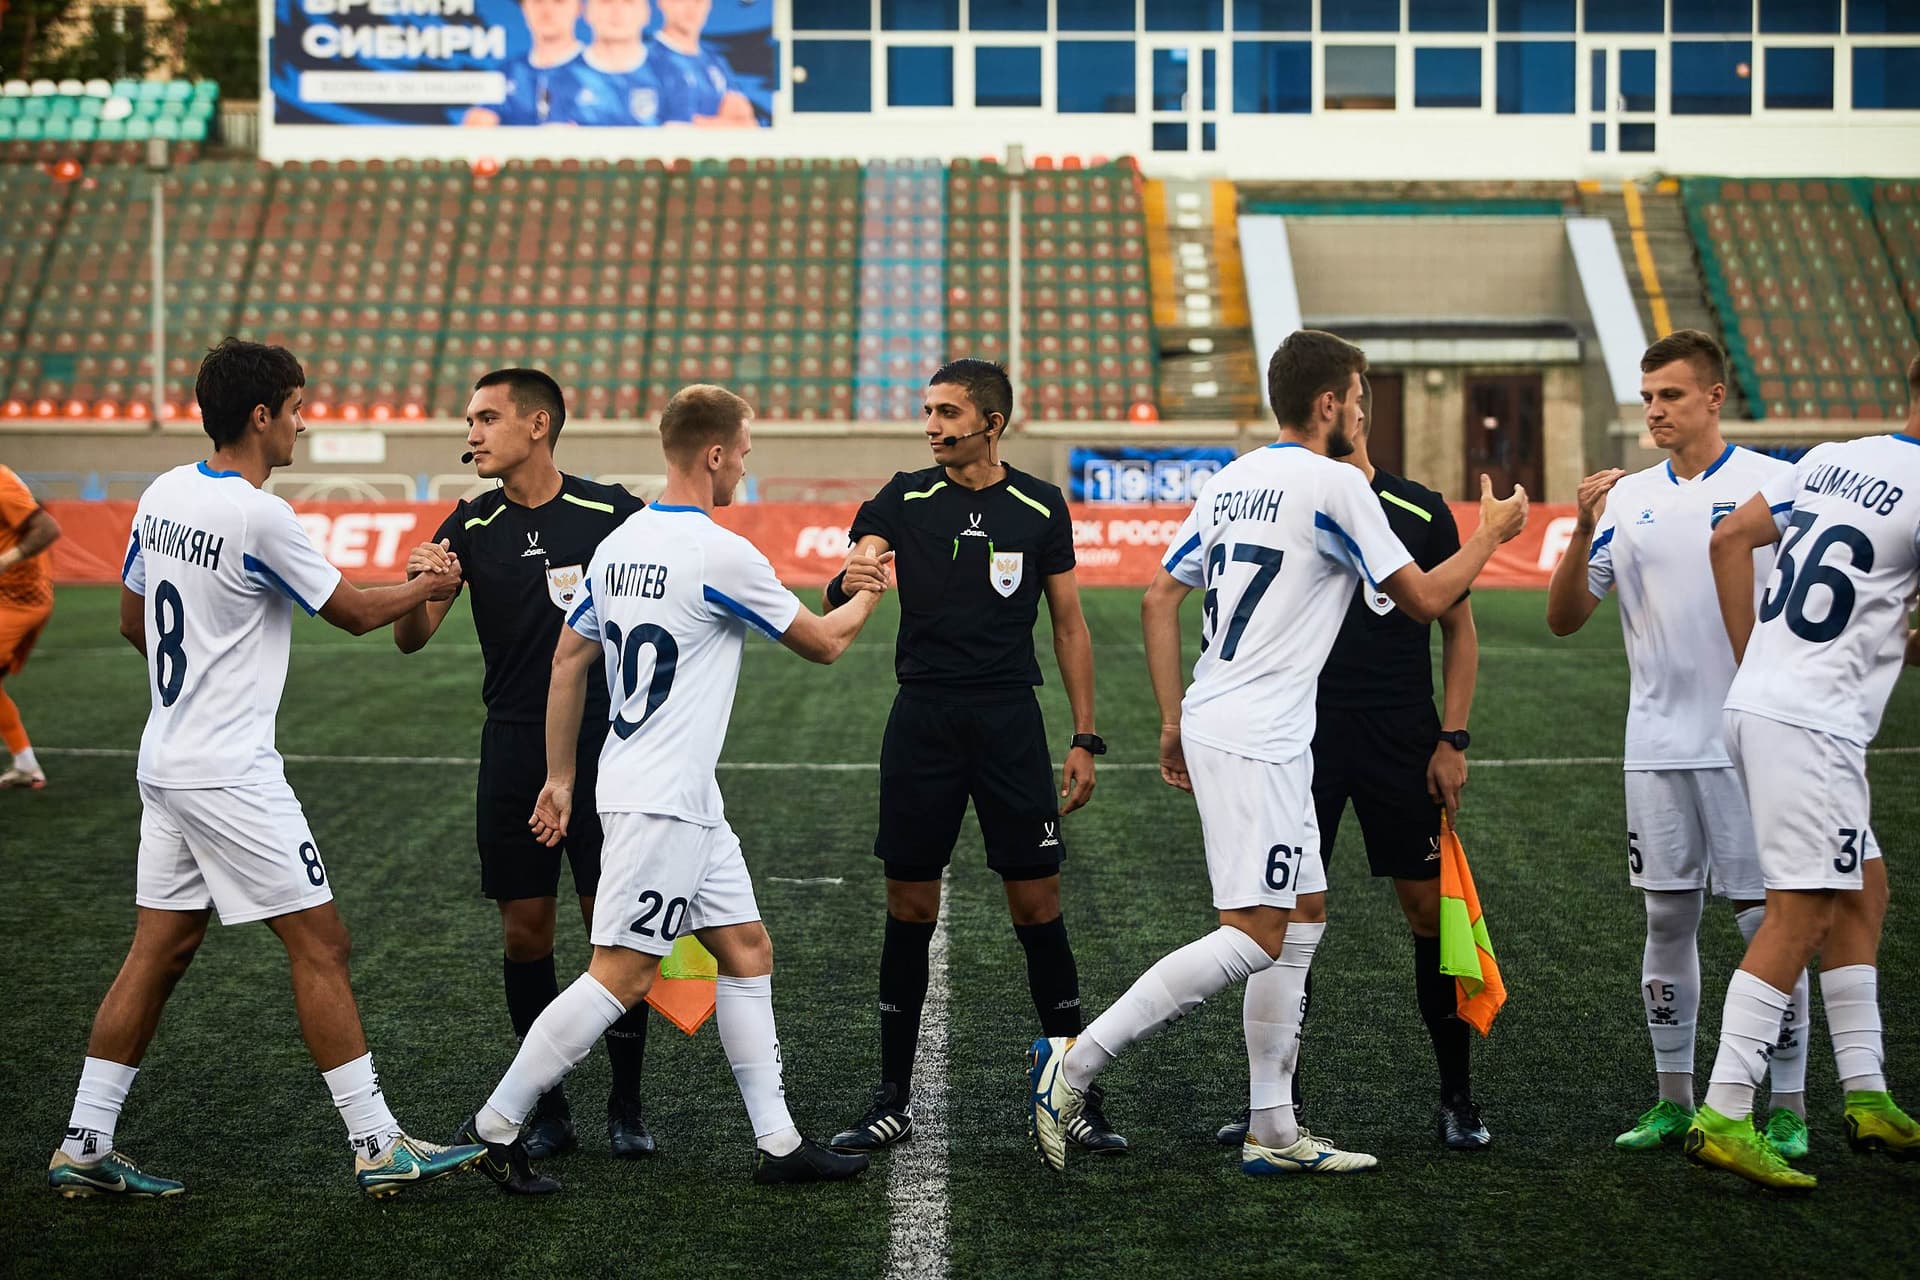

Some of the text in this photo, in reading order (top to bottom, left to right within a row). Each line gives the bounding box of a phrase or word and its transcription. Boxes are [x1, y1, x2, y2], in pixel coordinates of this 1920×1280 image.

[302, 24, 506, 58] СИБИРИ
[1213, 488, 1284, 527] ЕРОХИН
[1804, 463, 1904, 517] ШМАКОВ
[1759, 509, 1875, 643] 36
[1201, 542, 1285, 662] 67
[154, 579, 188, 708] 8
[299, 841, 325, 886] 8
[1833, 828, 1867, 874] 3
[629, 889, 688, 942] 20
[1645, 983, 1675, 1002] 15
